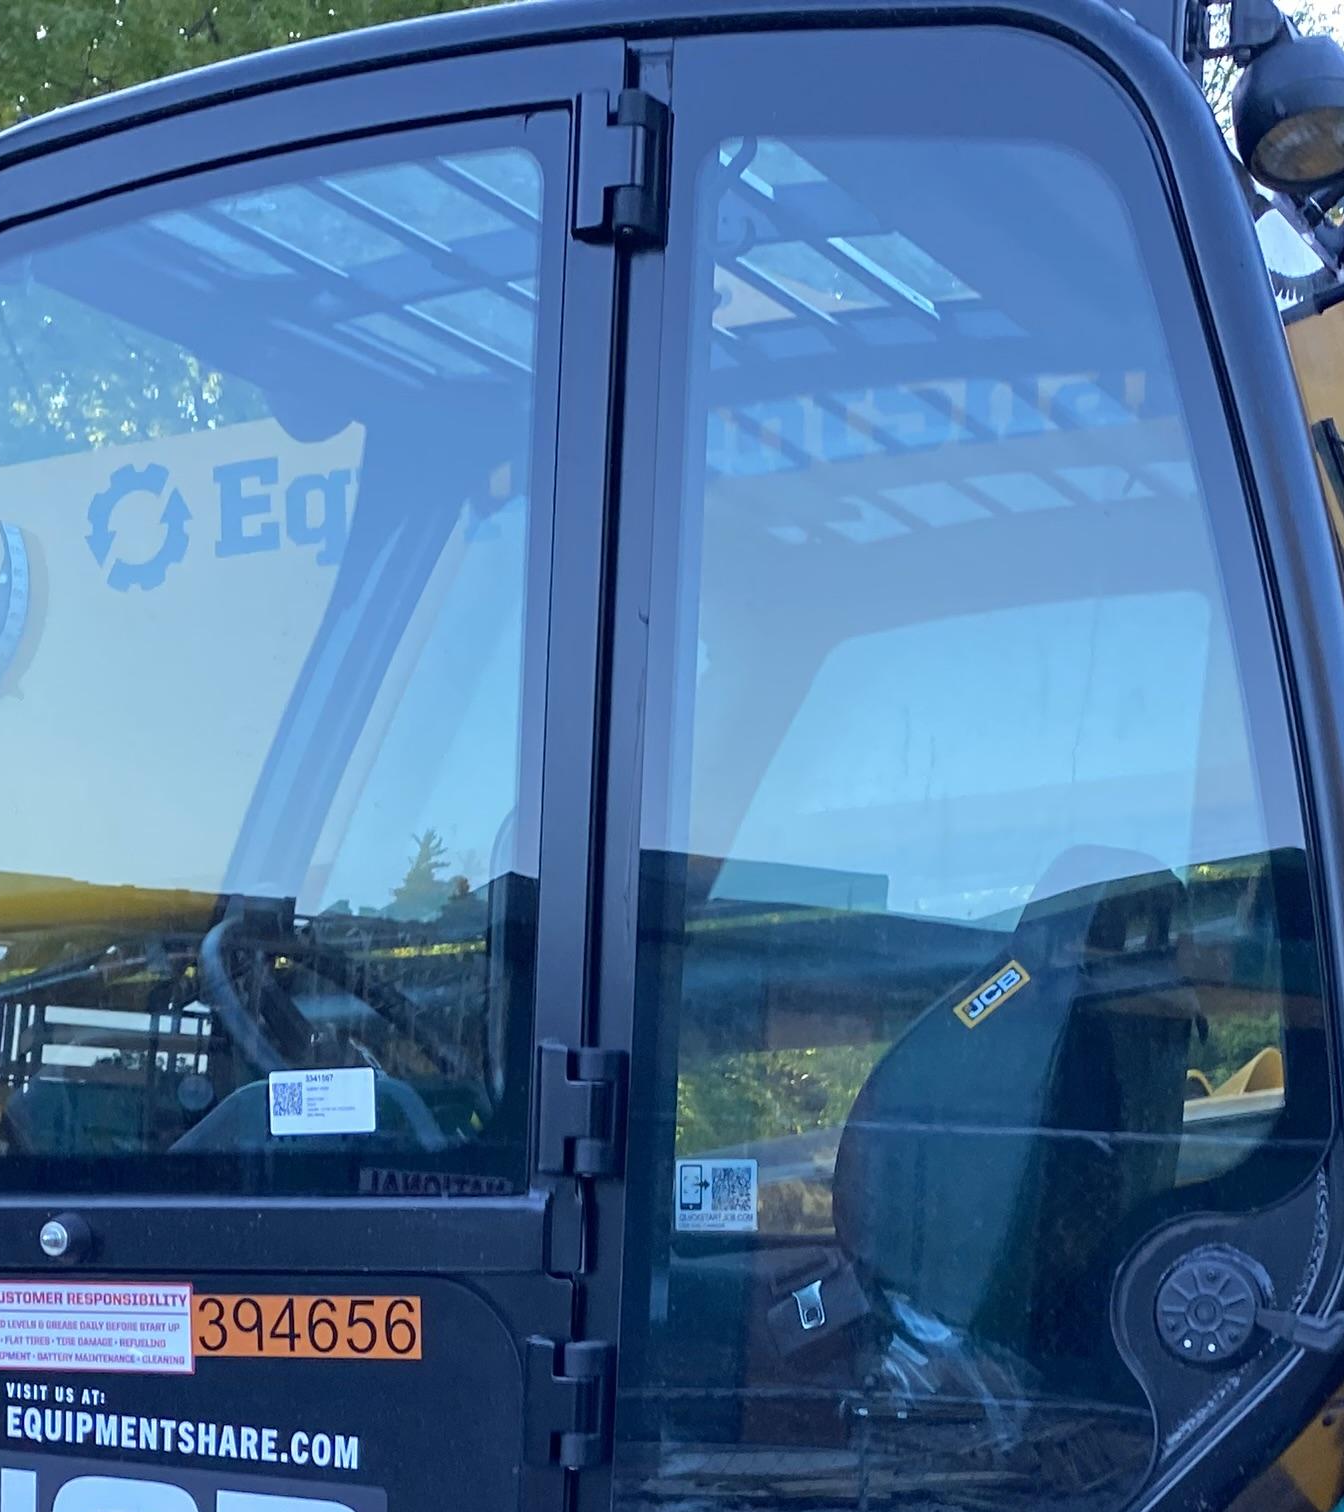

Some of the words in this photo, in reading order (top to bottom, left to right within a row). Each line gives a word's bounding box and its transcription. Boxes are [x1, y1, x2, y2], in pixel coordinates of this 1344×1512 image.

[213, 457, 351, 567] Eq
[968, 969, 1020, 1018] JCB
[67, 1292, 187, 1307] RESPONSIBILITY
[8, 1320, 36, 1329] LEVELS
[46, 1320, 78, 1330] GREASE
[80, 1321, 104, 1330] DAILY
[106, 1321, 138, 1331] BEFORE
[140, 1322, 166, 1332] START
[168, 1323, 180, 1332] UP
[198, 1297, 416, 1355] 394656
[5, 1335, 23, 1345] FLAT
[25, 1336, 50, 1345] TIRES
[78, 1337, 112, 1347] DAMAGE
[119, 1338, 166, 1348] REFUELING
[37, 1352, 73, 1361] BATTERY
[75, 1353, 135, 1363] MAINTENANCE
[142, 1355, 185, 1365] CLEANING
[6, 1382, 47, 1401] VISIT
[55, 1386, 74, 1404] US
[81, 1389, 105, 1405] AT:
[7, 1405, 359, 1470] EQUIPMENTSHARE.COM
